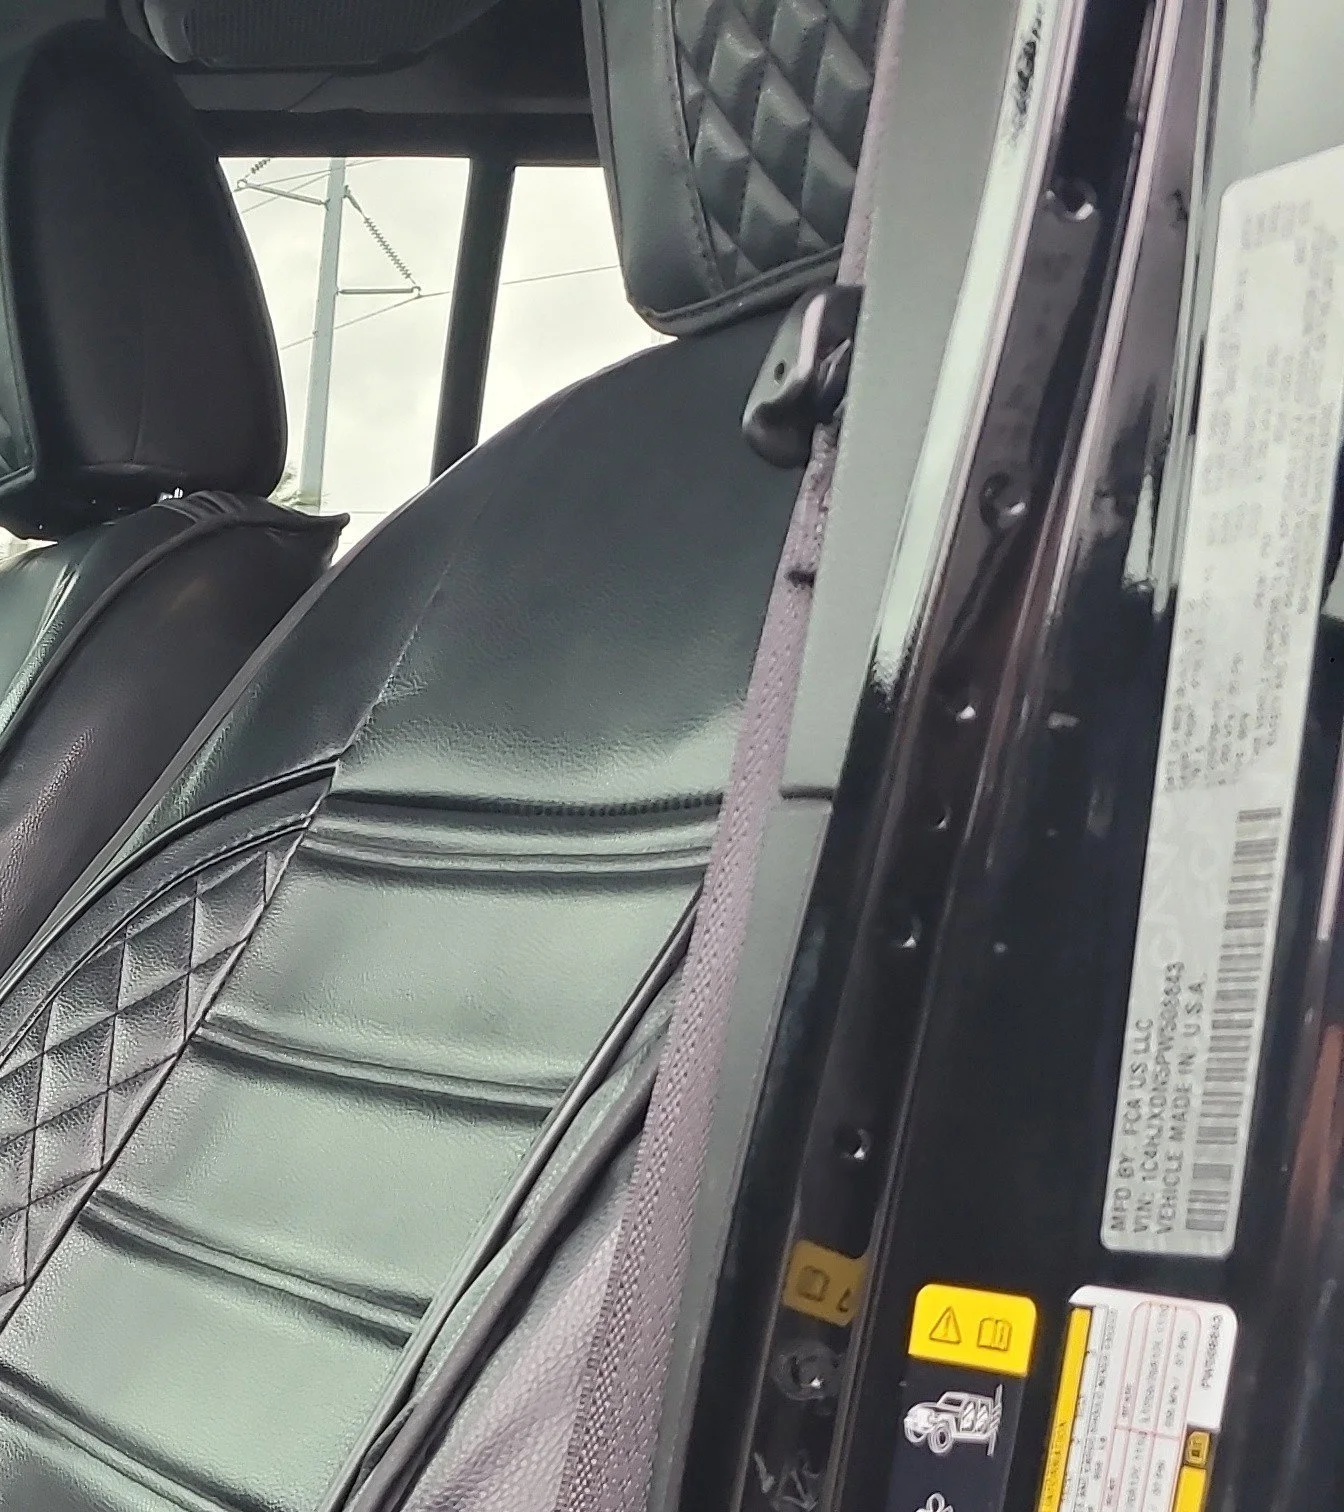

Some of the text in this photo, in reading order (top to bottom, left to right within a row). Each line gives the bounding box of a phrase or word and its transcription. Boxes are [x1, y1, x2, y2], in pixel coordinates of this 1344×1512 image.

[1132, 1016, 1153, 1055] LLC
[1128, 1060, 1147, 1089] US
[1122, 1096, 1142, 1135] FCA
[1168, 1081, 1192, 1142] MADE
[1155, 1150, 1183, 1235] VEHICLE
